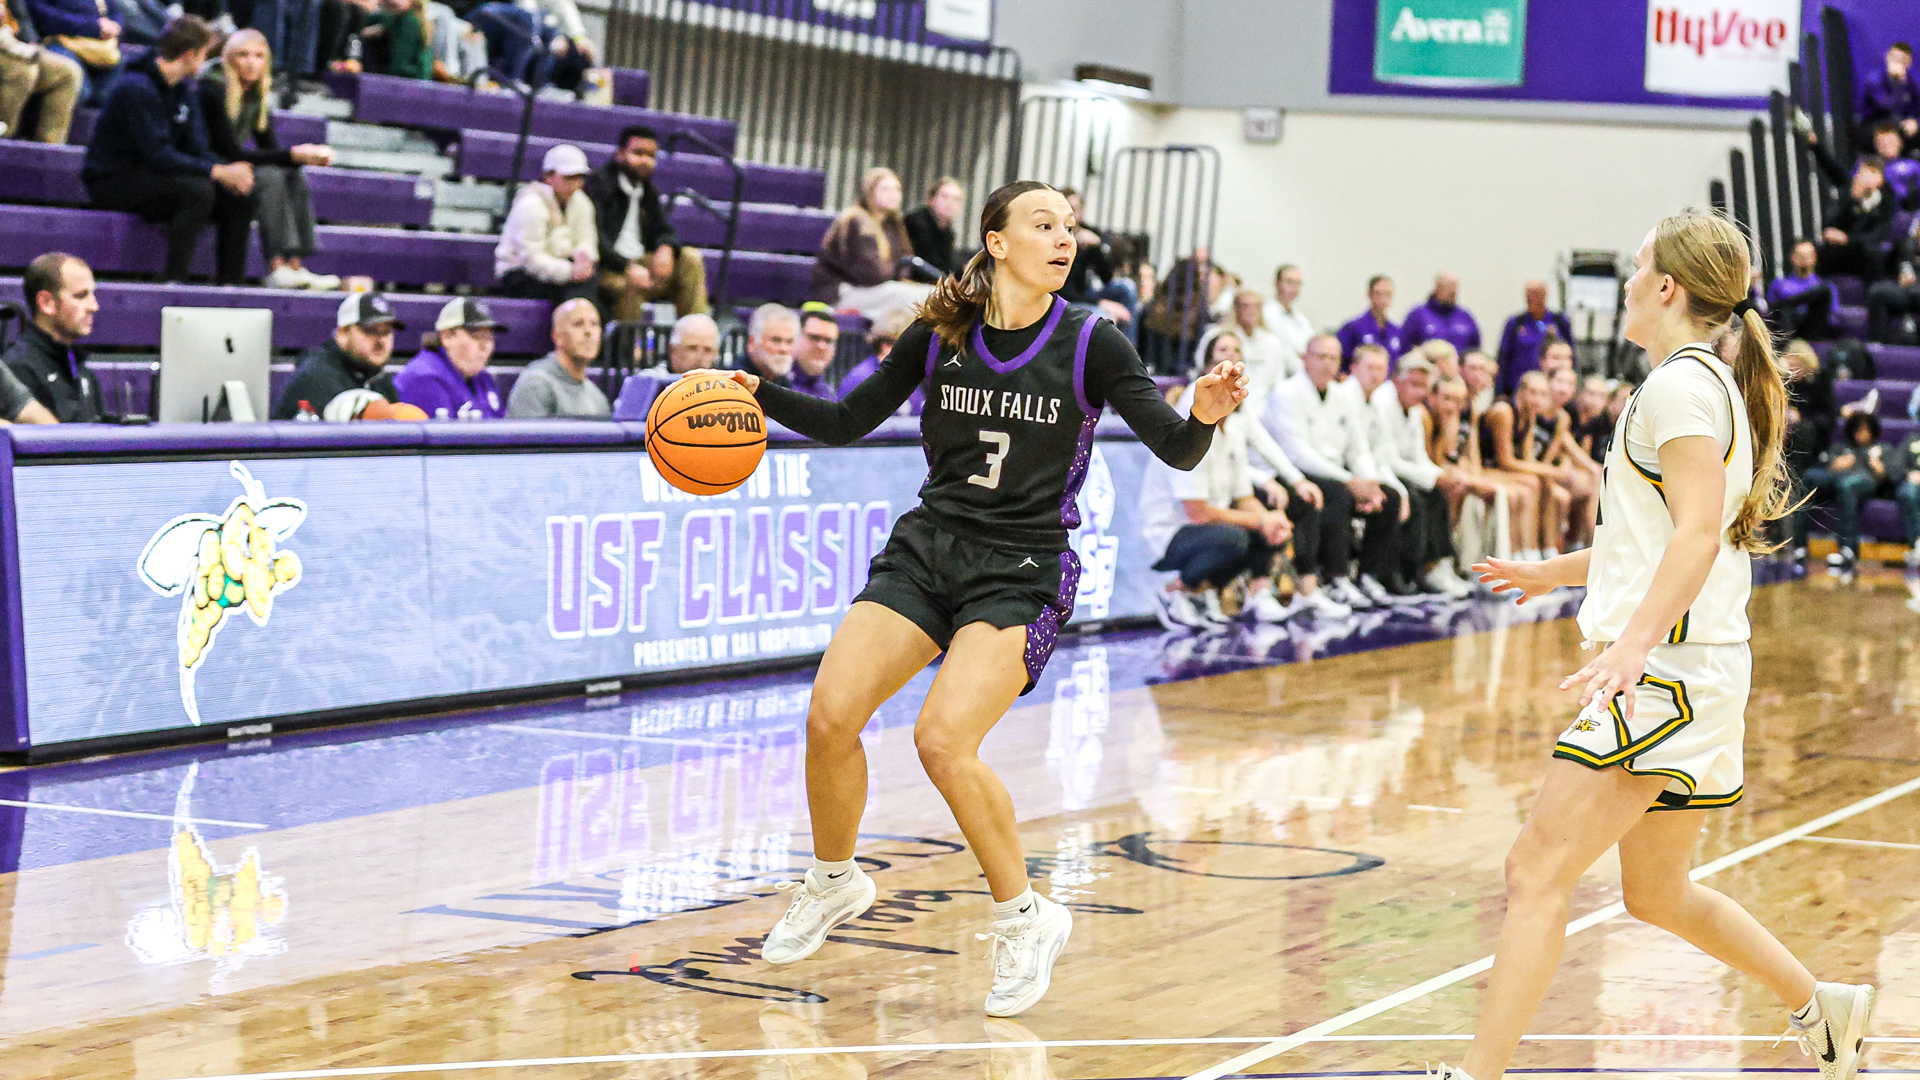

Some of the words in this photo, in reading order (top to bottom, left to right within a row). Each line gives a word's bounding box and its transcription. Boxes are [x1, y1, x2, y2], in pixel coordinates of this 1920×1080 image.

[687, 412, 761, 433] Wilson
[940, 384, 994, 417] SIOUX
[1000, 391, 1061, 424] FALLS
[967, 430, 1011, 490] 3
[545, 511, 666, 640] USF
